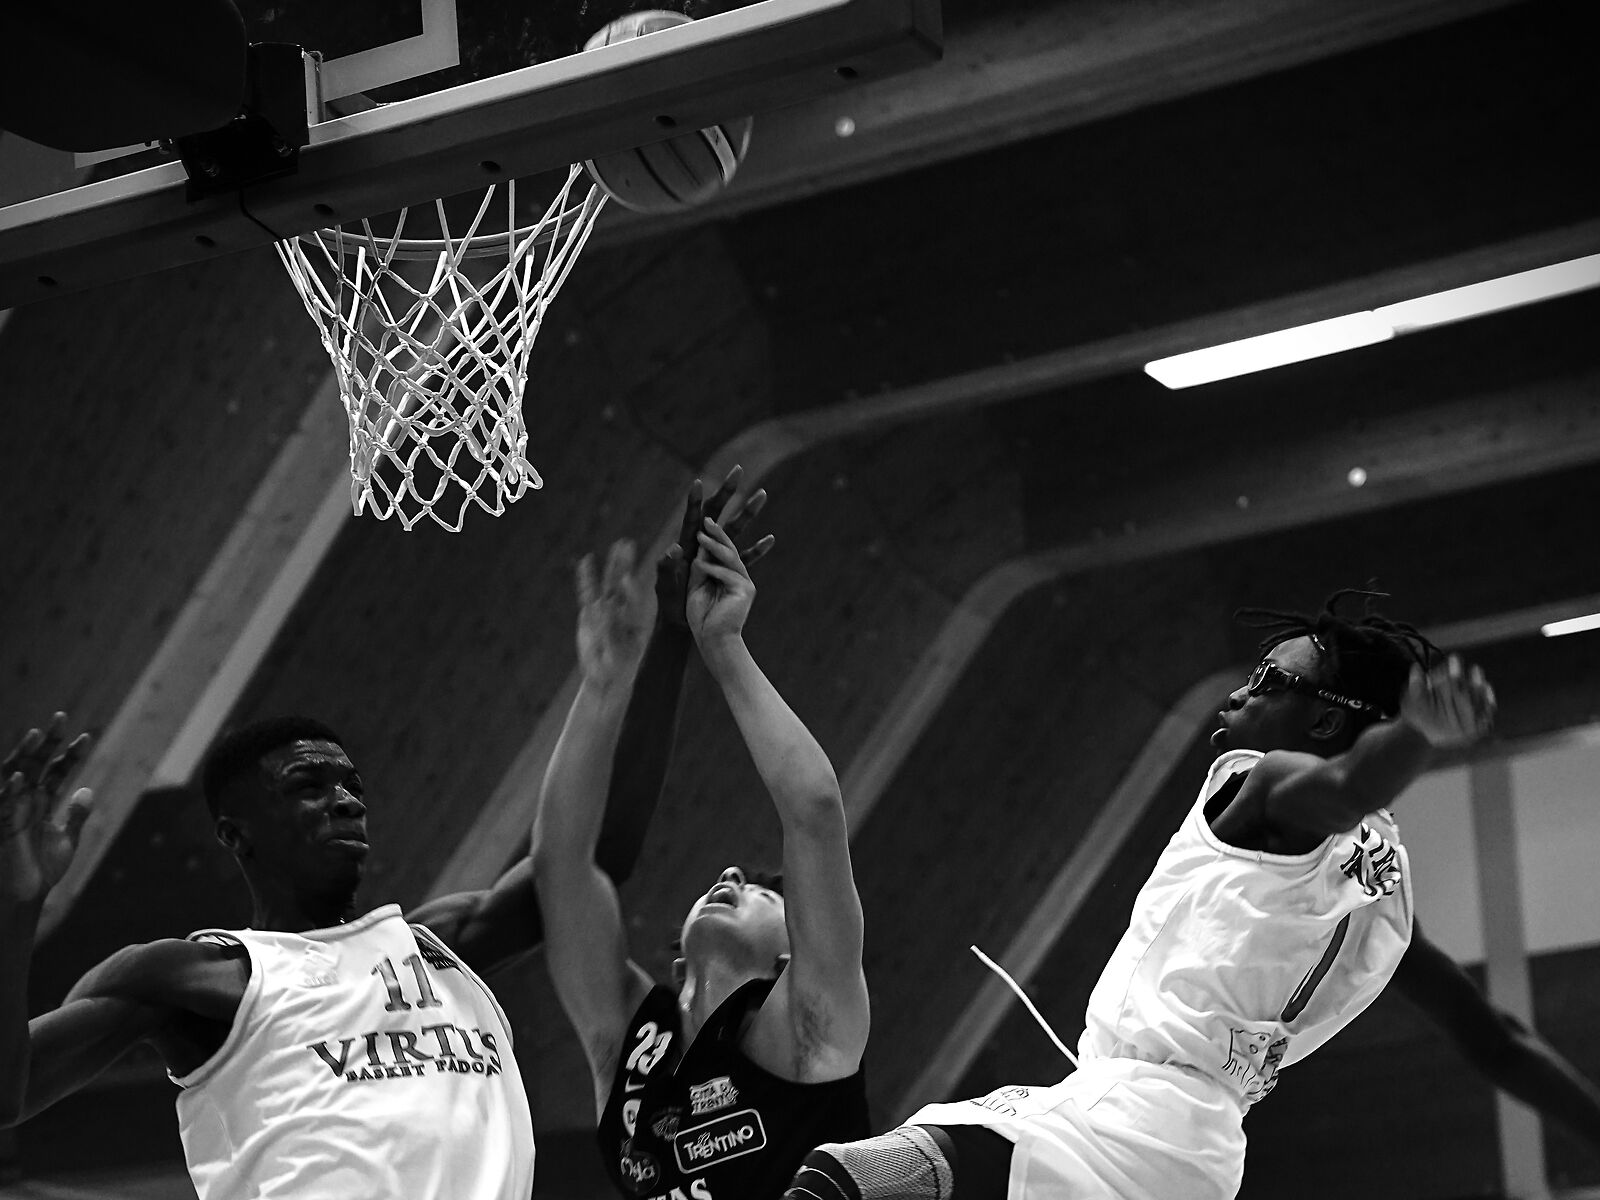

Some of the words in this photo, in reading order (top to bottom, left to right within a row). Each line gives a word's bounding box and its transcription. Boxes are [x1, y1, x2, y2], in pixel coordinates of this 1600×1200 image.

[371, 953, 442, 1011] 11
[307, 1022, 502, 1078] VIRTUS
[346, 1063, 425, 1082] BASKET
[683, 1125, 754, 1161] TRENTINO
